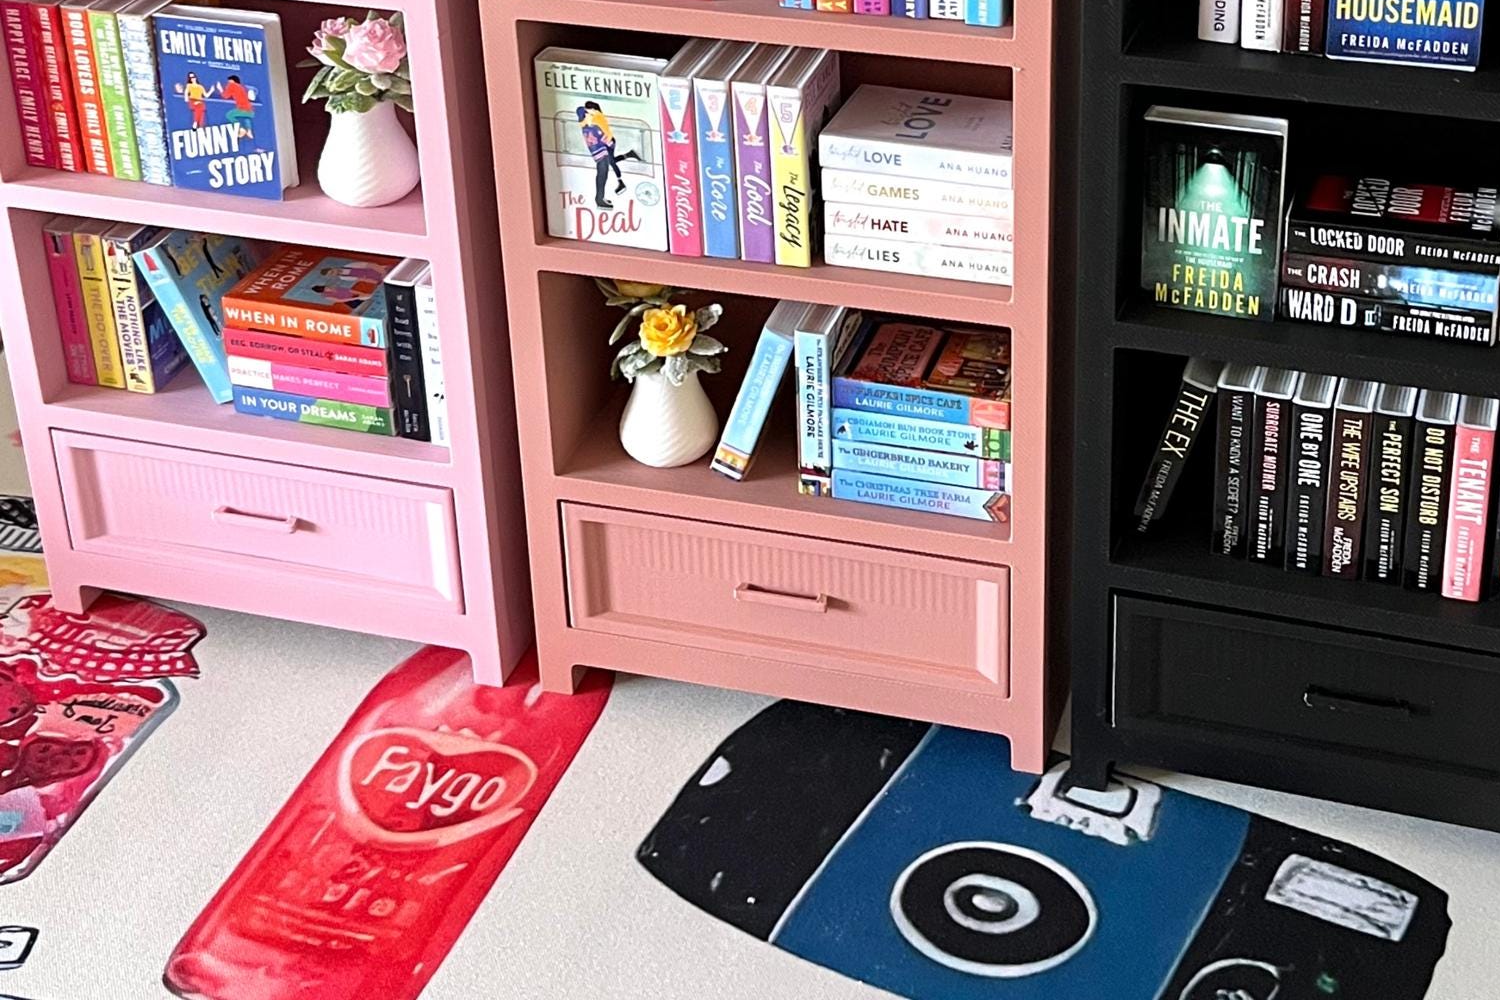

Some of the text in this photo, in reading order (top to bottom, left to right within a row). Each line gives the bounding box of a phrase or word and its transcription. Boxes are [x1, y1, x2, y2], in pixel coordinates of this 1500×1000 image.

[161, 29, 263, 64] EMILY HENRY
[1341, 34, 1389, 49] FREIDA
[1396, 38, 1469, 55] McFADDEN
[545, 72, 651, 98] ELLE KENNEDY
[172, 122, 241, 160] FUNNY
[864, 151, 902, 166] LOVE
[209, 152, 274, 189] STORY
[559, 192, 586, 210] The
[669, 175, 694, 237] Mistake
[706, 166, 730, 221] Score
[743, 174, 772, 227] Goal
[868, 185, 920, 200] GAMES
[1200, 201, 1222, 212] THE
[575, 200, 641, 241] Deal
[779, 185, 805, 248] Legacy
[871, 219, 909, 233] HATE
[1158, 207, 1264, 255] INMATE
[868, 249, 900, 263] LIES
[1310, 227, 1405, 256] LOCKED DOOR
[1173, 264, 1243, 291] FREIDA
[1307, 264, 1360, 289] CRASH
[1155, 282, 1260, 317] McFADDEN
[1288, 289, 1357, 326] WARD D
[226, 307, 352, 338] WHEN IN ROME
[242, 395, 356, 423] IN YOUR DREAMS
[855, 398, 944, 418] LAURIE GILMORE
[1161, 390, 1208, 459] THE EX
[1297, 412, 1324, 488] ONE BY ONE
[1337, 418, 1363, 522] THE WIFE UPSTAIRS
[1419, 428, 1445, 526] DO NOT DISTURB
[1455, 458, 1487, 526] TENANT
[362, 745, 508, 819] Faygo
